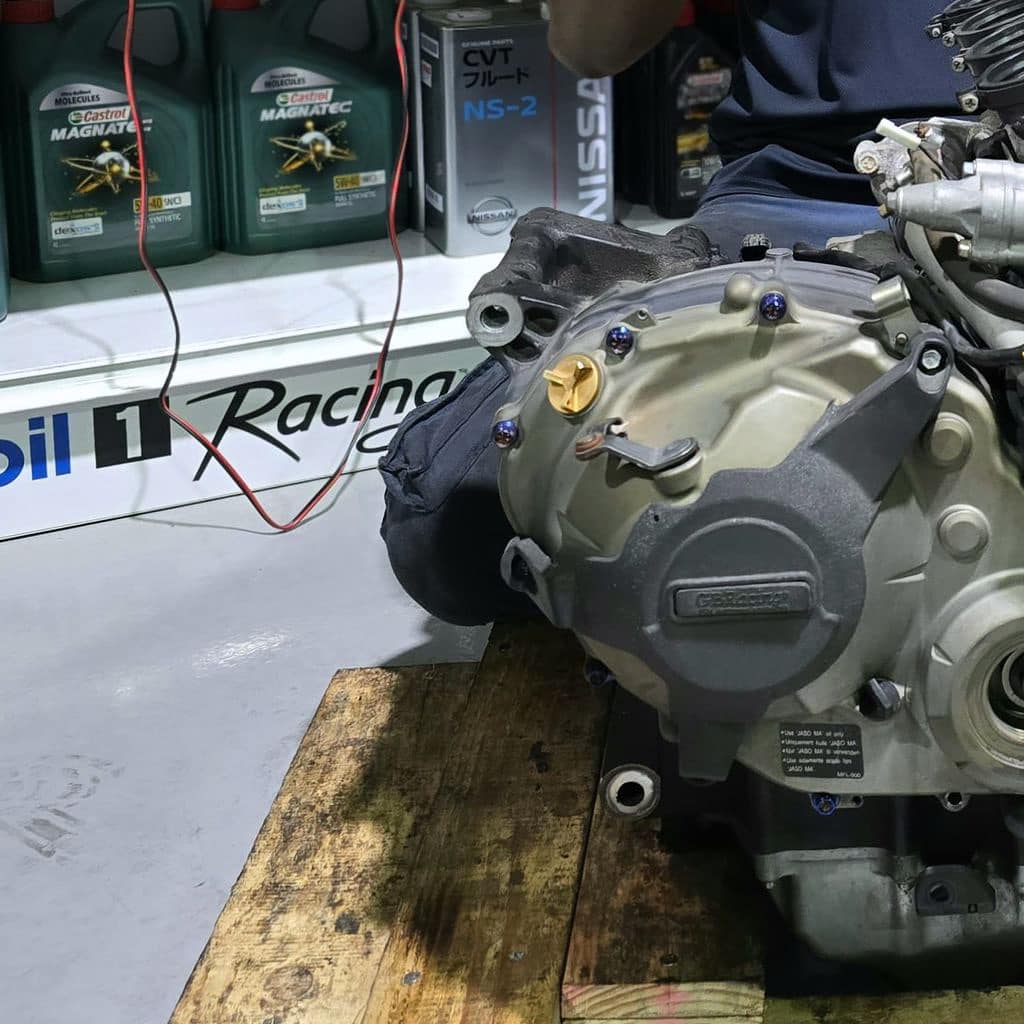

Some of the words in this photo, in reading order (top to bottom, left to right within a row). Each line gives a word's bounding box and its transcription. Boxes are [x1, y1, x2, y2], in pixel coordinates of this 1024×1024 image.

[463, 47, 513, 67] CVT
[463, 67, 529, 88] フルード
[55, 94, 100, 106] MOLECULES
[290, 90, 329, 103] Castrol
[84, 108, 127, 122] Castrol
[260, 100, 353, 122] MAGNATEC
[464, 95, 537, 122] NS-2
[577, 76, 607, 221] NISSA
[135, 196, 162, 211] 5-40
[472, 210, 514, 223] NISSAN
[186, 369, 460, 483] Racing
